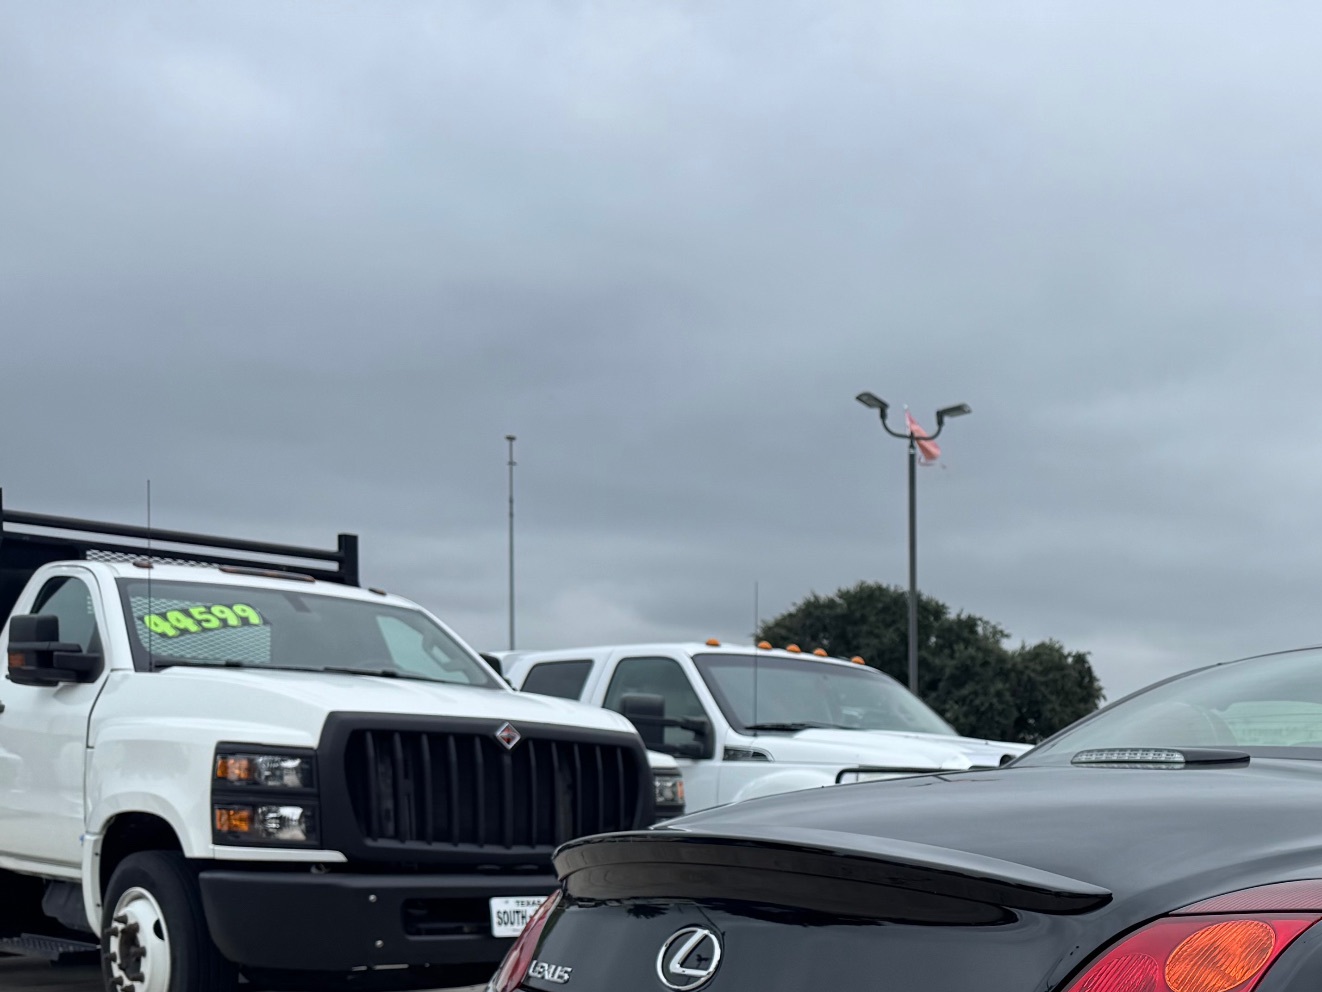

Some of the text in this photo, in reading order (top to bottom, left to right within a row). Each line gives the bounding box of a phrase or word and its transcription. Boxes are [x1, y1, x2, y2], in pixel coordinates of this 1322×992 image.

[144, 603, 263, 637] 44599
[496, 909, 527, 926] SOUTH
[529, 960, 573, 983] LEXUS
